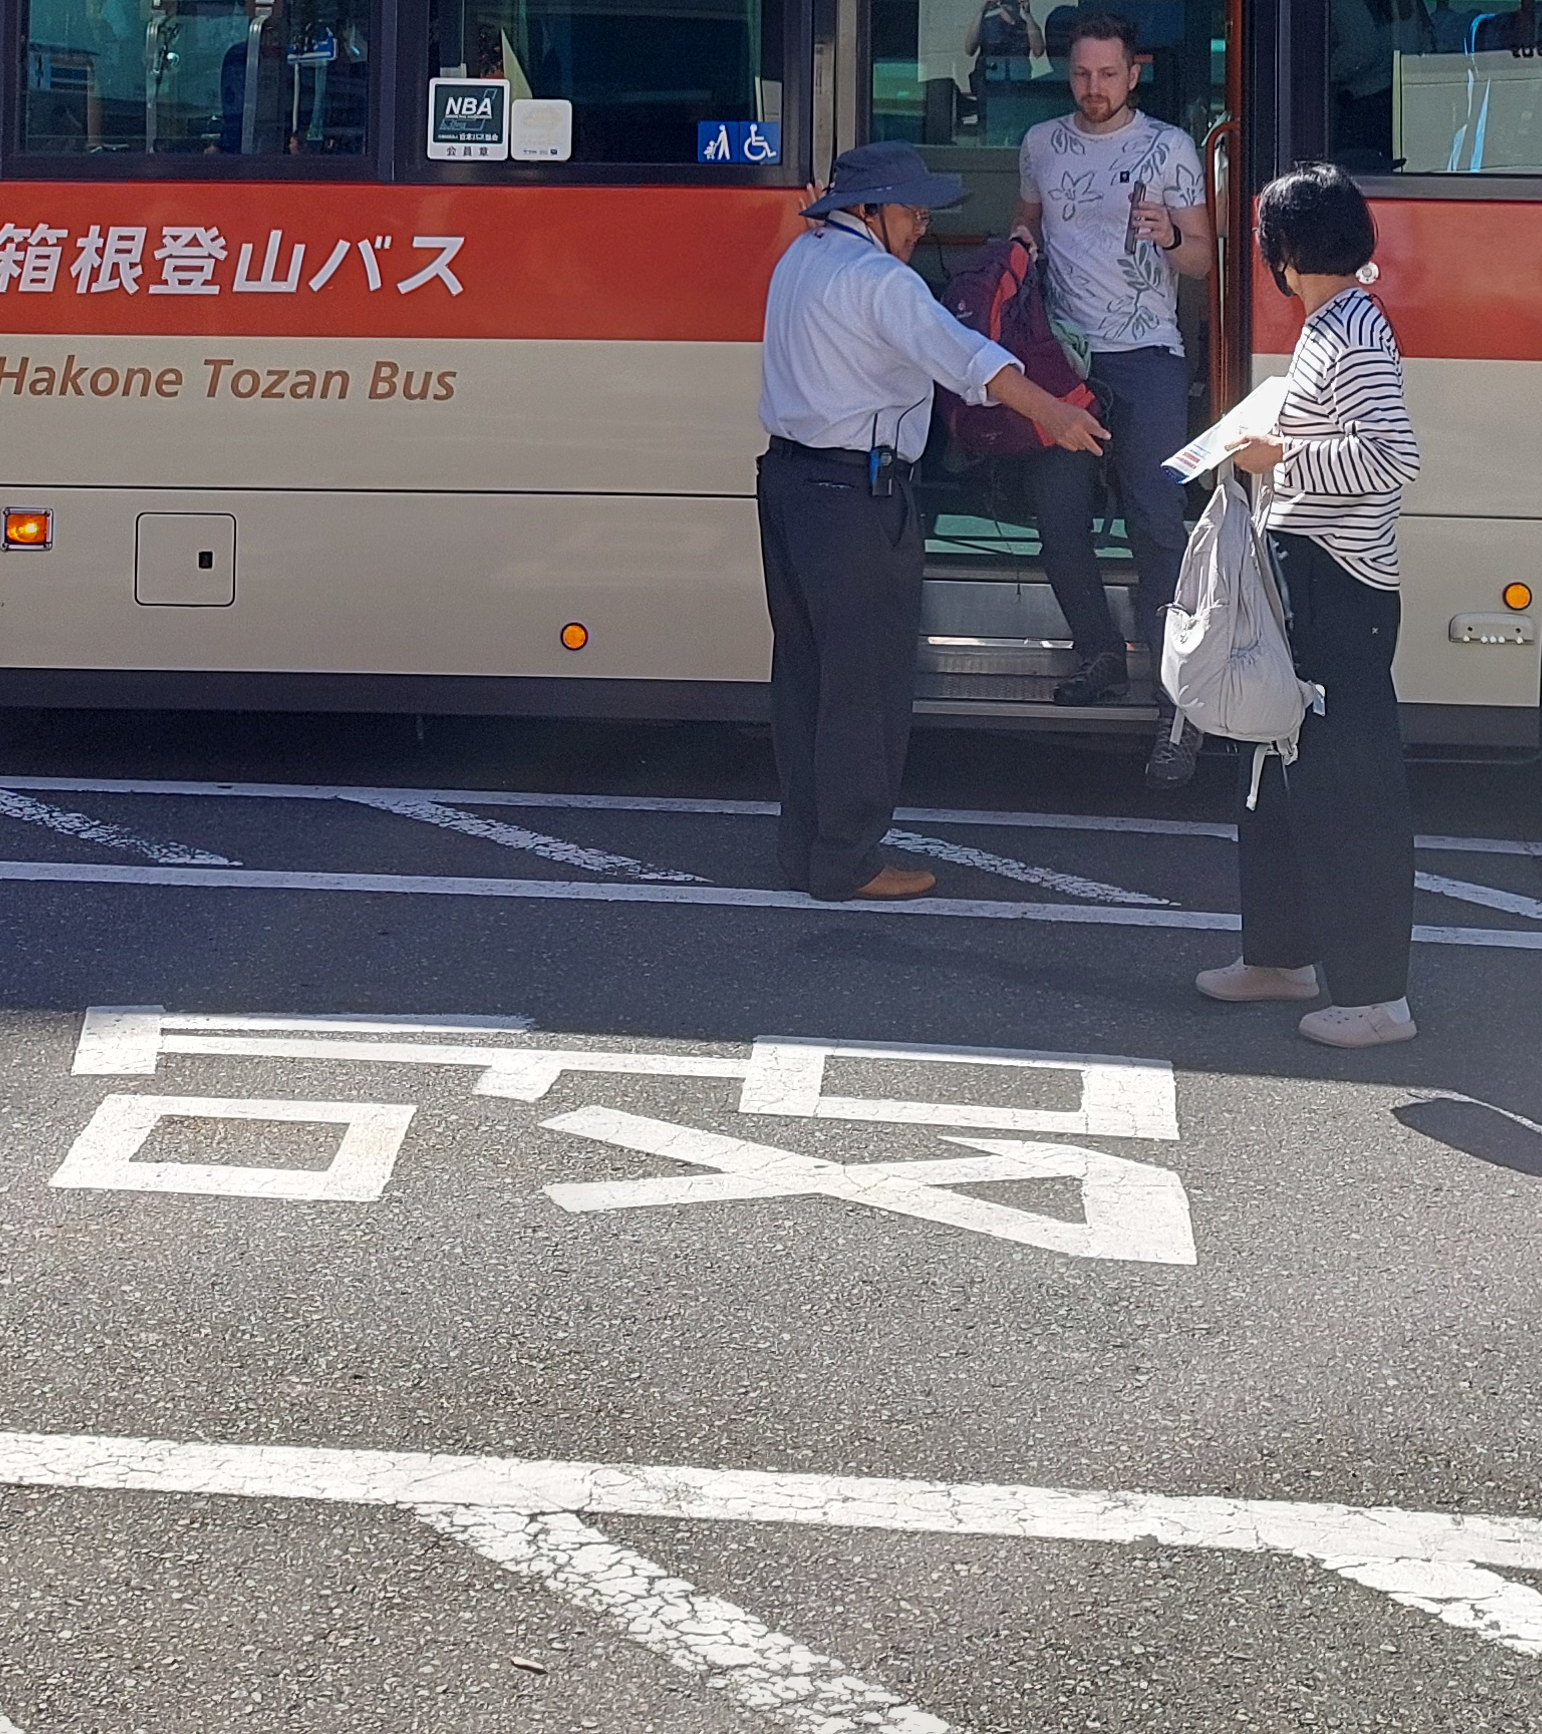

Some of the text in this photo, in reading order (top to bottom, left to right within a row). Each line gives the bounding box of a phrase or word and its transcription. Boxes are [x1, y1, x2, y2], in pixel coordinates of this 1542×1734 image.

[445, 97, 492, 116] NBA
[202, 358, 351, 401] Tozan
[367, 360, 458, 402] Bus
